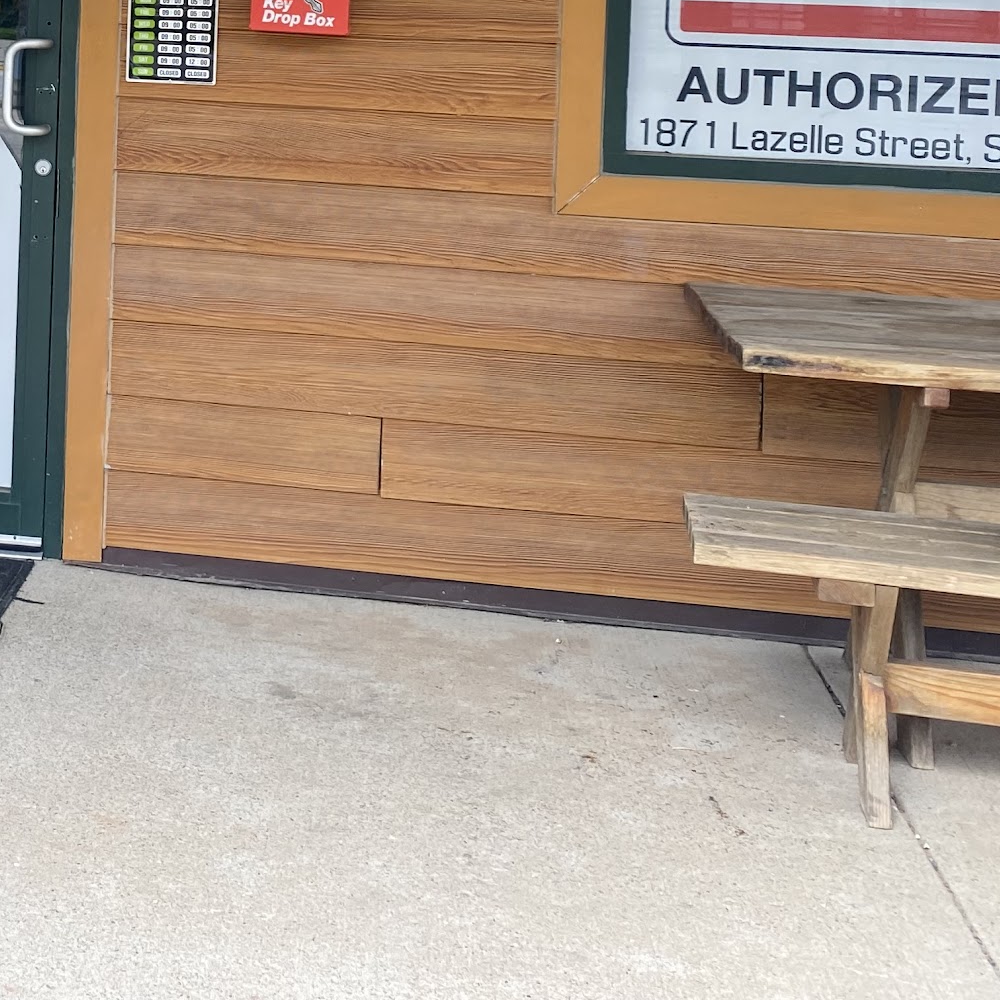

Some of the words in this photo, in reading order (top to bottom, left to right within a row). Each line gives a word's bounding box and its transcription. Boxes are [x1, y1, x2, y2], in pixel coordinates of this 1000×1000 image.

[261, 9, 301, 27] Drop
[303, 12, 335, 27] Box
[676, 66, 1000, 117] AUTHORIZE
[640, 117, 715, 149] 1871
[731, 121, 844, 155] Lazelle
[855, 127, 971, 164] Street,
